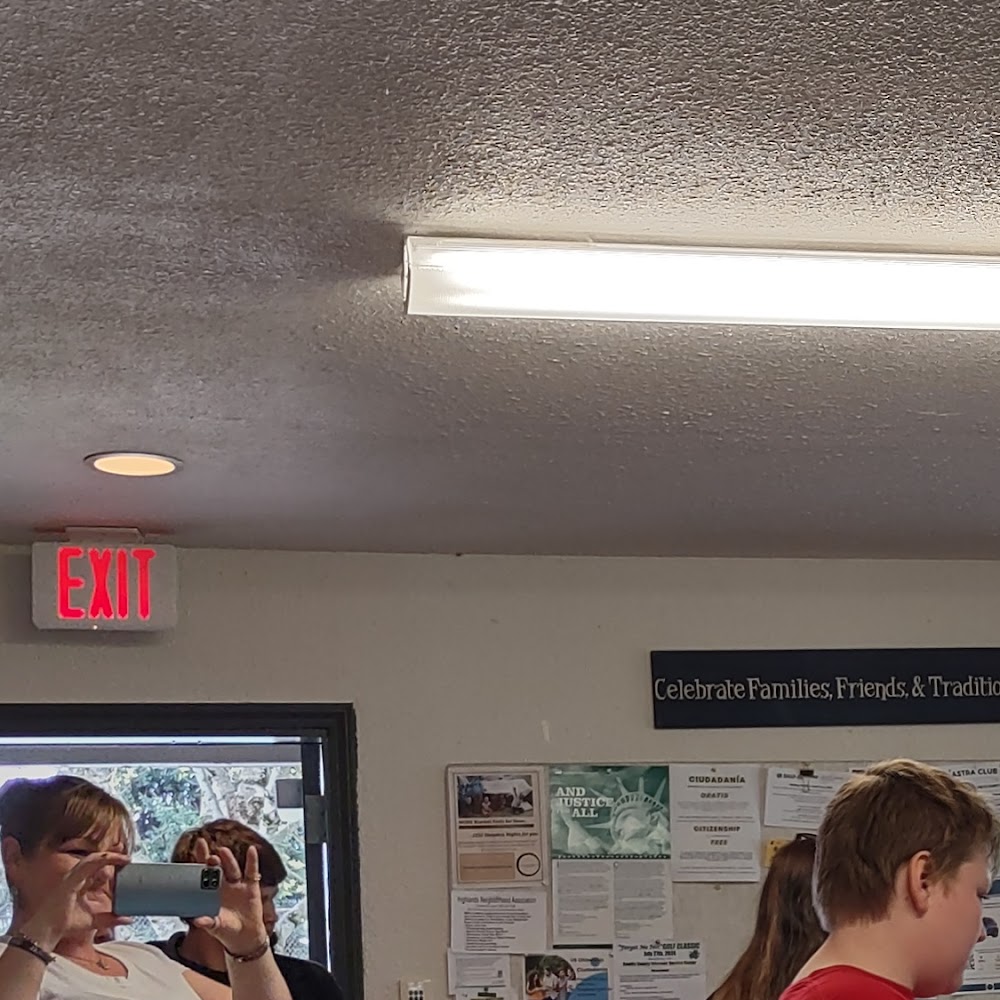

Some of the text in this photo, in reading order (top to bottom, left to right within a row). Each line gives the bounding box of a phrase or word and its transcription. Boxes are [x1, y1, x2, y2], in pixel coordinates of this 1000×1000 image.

[57, 546, 156, 620] EXIT
[654, 678, 746, 701] Celebrate
[748, 677, 833, 702] Families,
[911, 675, 926, 698] &
[977, 767, 998, 775] CLUB
[688, 774, 746, 784] CIUDADANÍA
[555, 786, 586, 797] AND
[555, 797, 614, 807] JUSTICE
[572, 807, 598, 818] ALL
